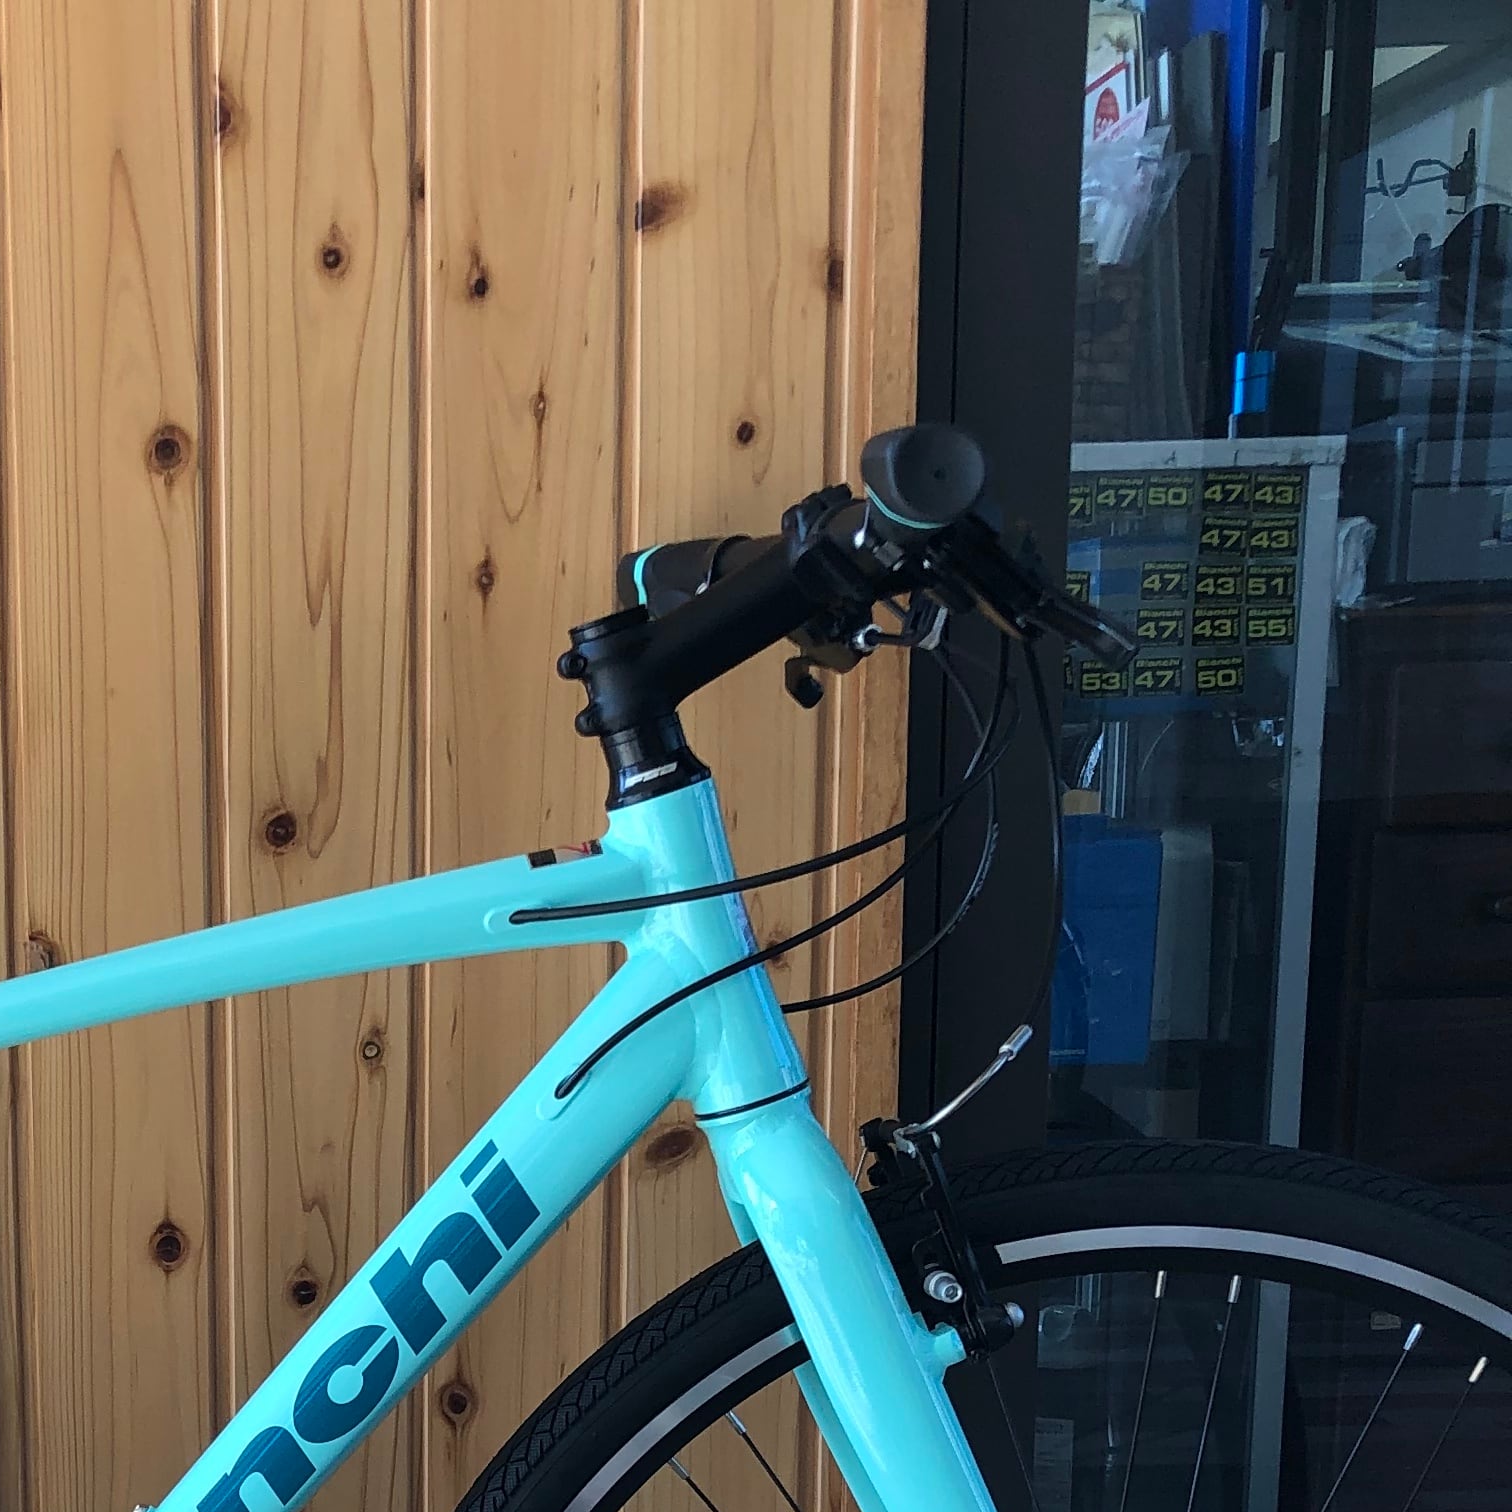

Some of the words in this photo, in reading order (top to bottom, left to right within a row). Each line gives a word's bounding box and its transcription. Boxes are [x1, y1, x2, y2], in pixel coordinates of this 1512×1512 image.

[1096, 488, 1137, 508] 47
[1147, 486, 1188, 506] 50
[1204, 483, 1244, 503] 47
[1254, 485, 1294, 505] 43
[1068, 496, 1085, 517] 7
[1201, 529, 1241, 549] 47
[1249, 529, 1290, 549] 43
[1065, 583, 1082, 598] 7
[1142, 573, 1182, 593] 47
[1196, 576, 1236, 596] 43
[1247, 577, 1285, 597] 51
[1137, 620, 1178, 640] 47
[1193, 618, 1233, 638] 43
[1247, 618, 1287, 639] 55
[1081, 672, 1122, 692] 53
[1134, 670, 1175, 689] 47
[1197, 668, 1238, 689] 50
